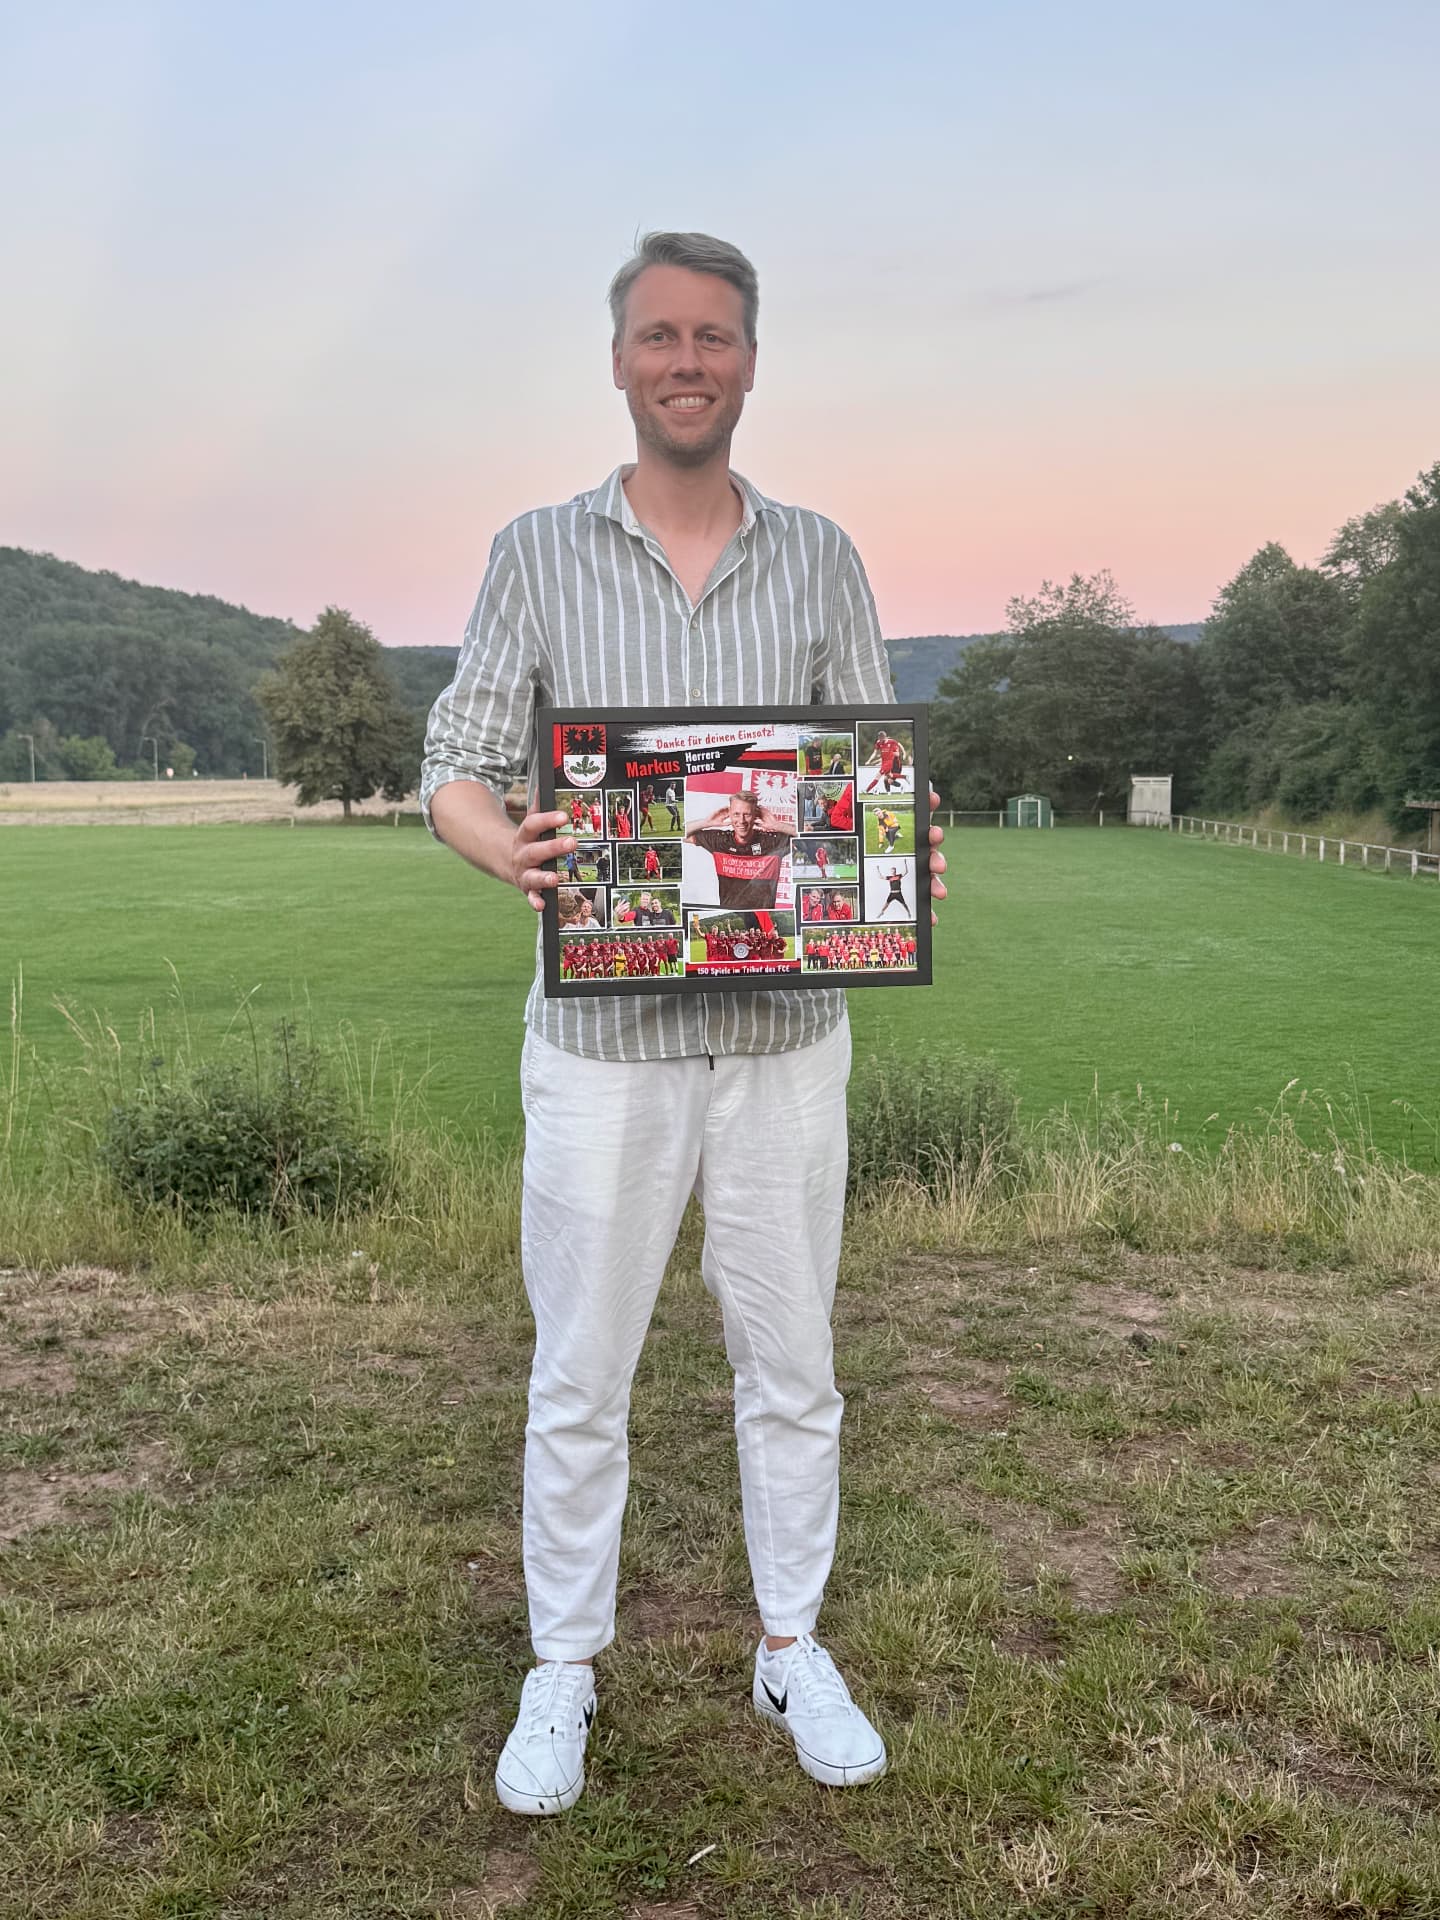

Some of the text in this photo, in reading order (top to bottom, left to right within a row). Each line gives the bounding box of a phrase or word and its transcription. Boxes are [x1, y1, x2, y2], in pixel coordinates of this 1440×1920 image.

[656, 725, 775, 750] Danke für deinen Einsatz!
[685, 750, 724, 763] Herrera-
[625, 759, 681, 778] Markus
[710, 967, 731, 976] Spiele
